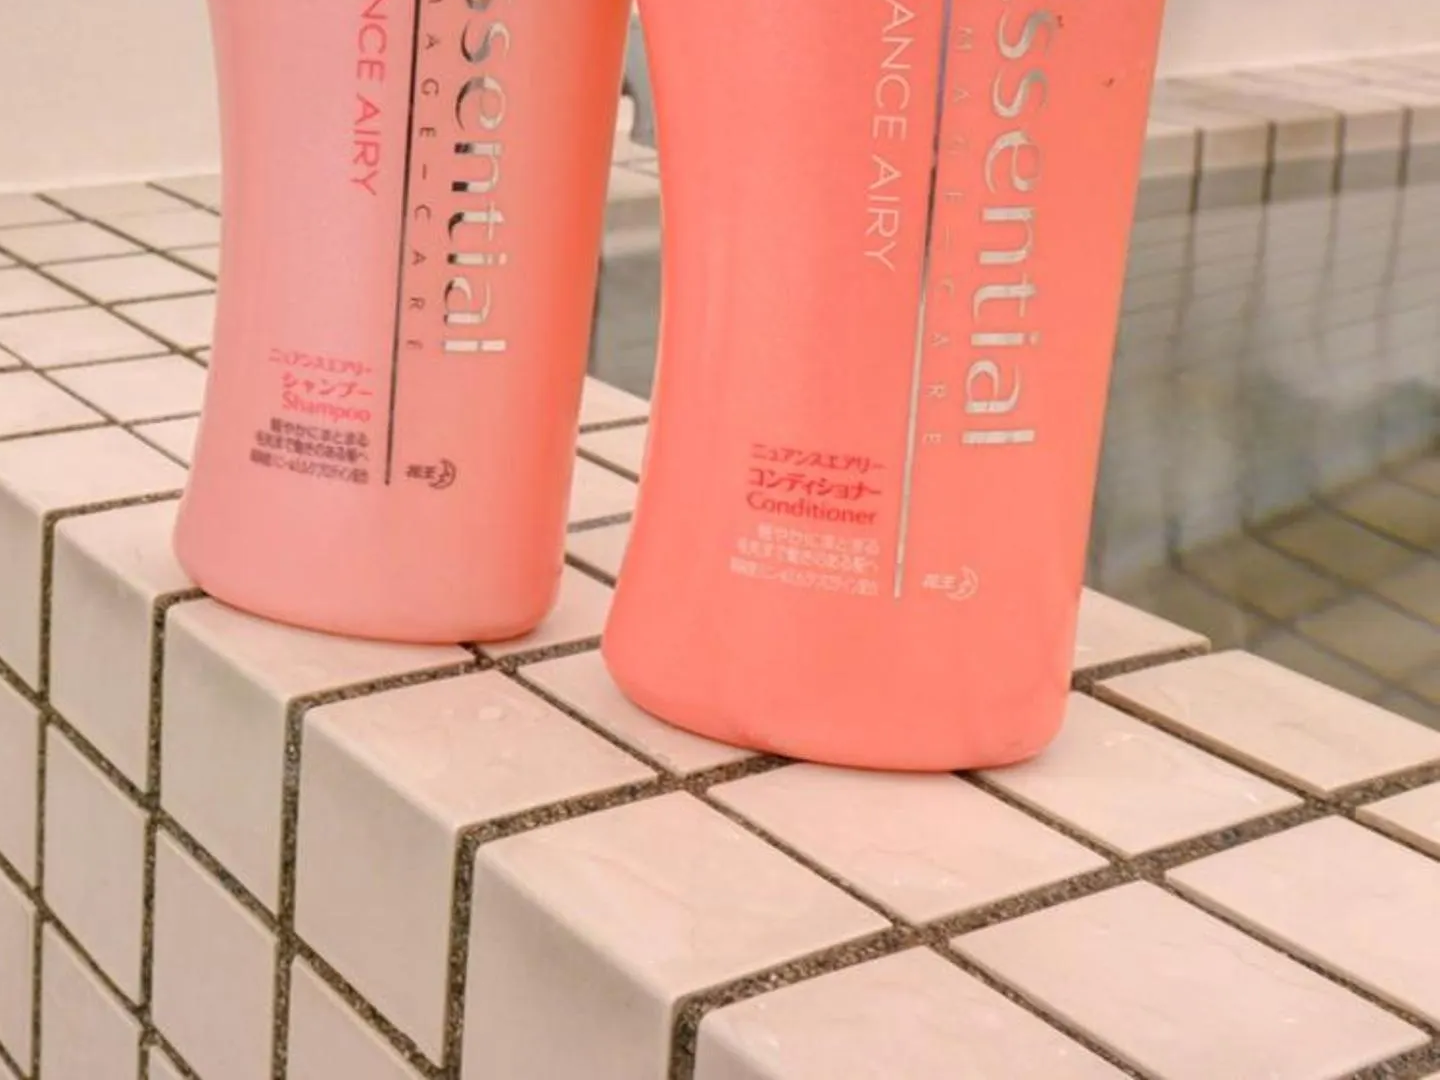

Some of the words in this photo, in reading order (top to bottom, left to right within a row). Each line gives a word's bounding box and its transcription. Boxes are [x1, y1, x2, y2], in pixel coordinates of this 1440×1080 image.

[351, 92, 381, 196] AIRY
[863, 154, 903, 272] AIRY
[281, 390, 371, 423] Shampoo
[747, 467, 882, 501] コンディショナー
[746, 490, 878, 526] Conditioner
